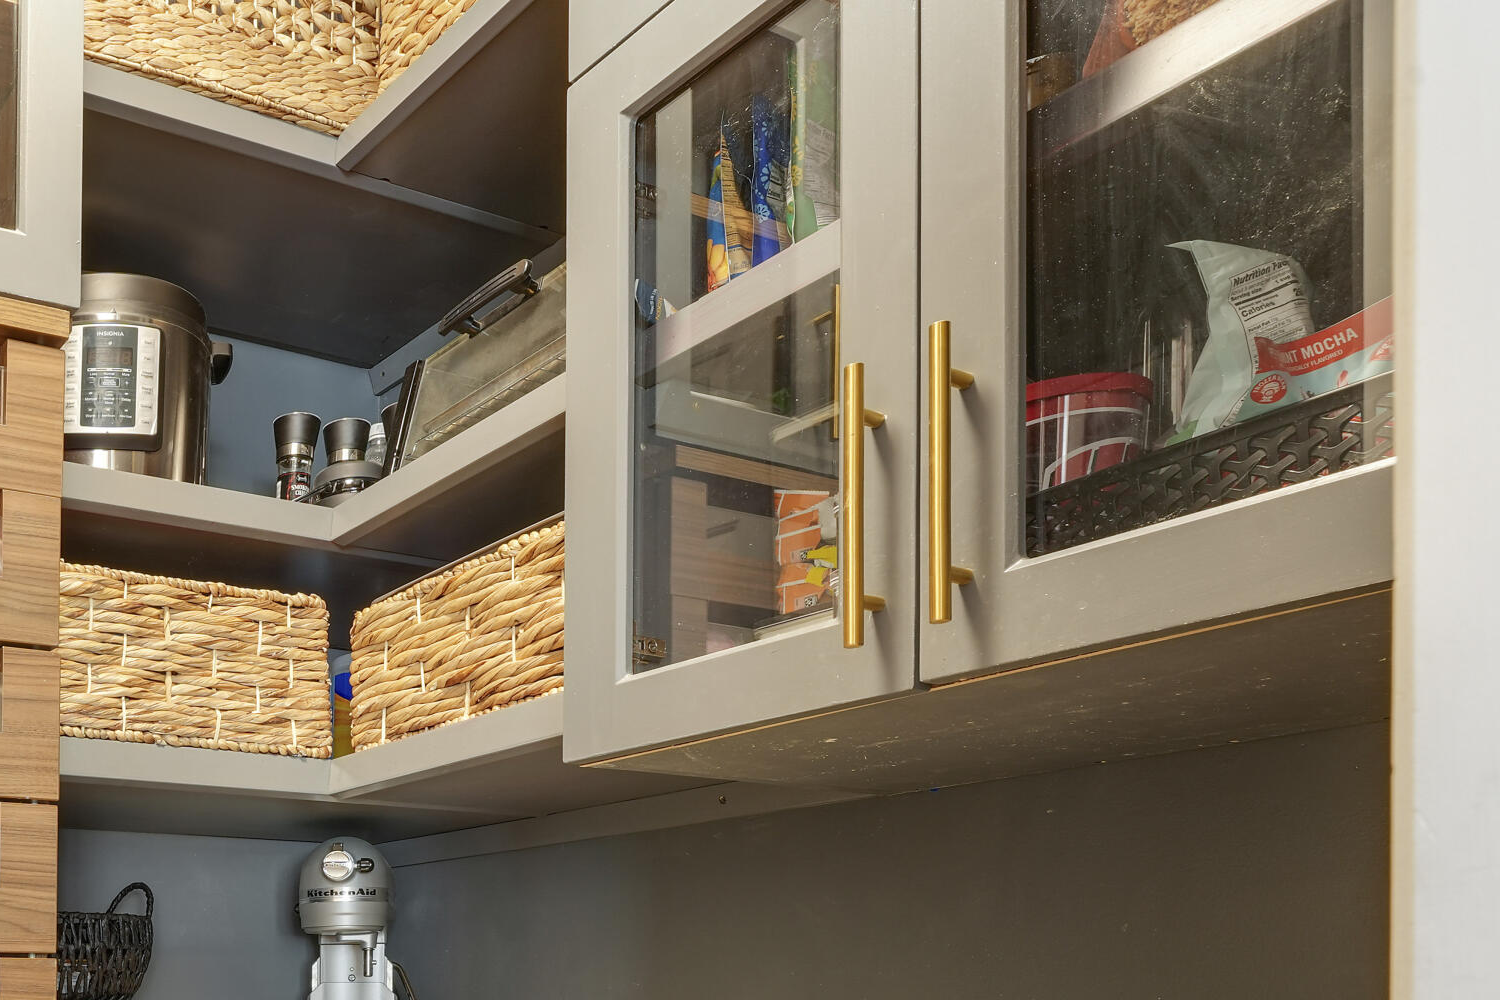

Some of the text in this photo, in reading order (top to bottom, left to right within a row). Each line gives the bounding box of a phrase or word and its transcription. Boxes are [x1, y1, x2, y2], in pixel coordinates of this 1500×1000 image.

[1233, 264, 1271, 287] Nutrition
[1241, 300, 1275, 318] Calories
[96, 330, 125, 338] INSIGNIA
[1301, 327, 1358, 360] MOCHA
[1310, 349, 1343, 367] FLAVORED
[306, 887, 377, 898] KitchenAid
